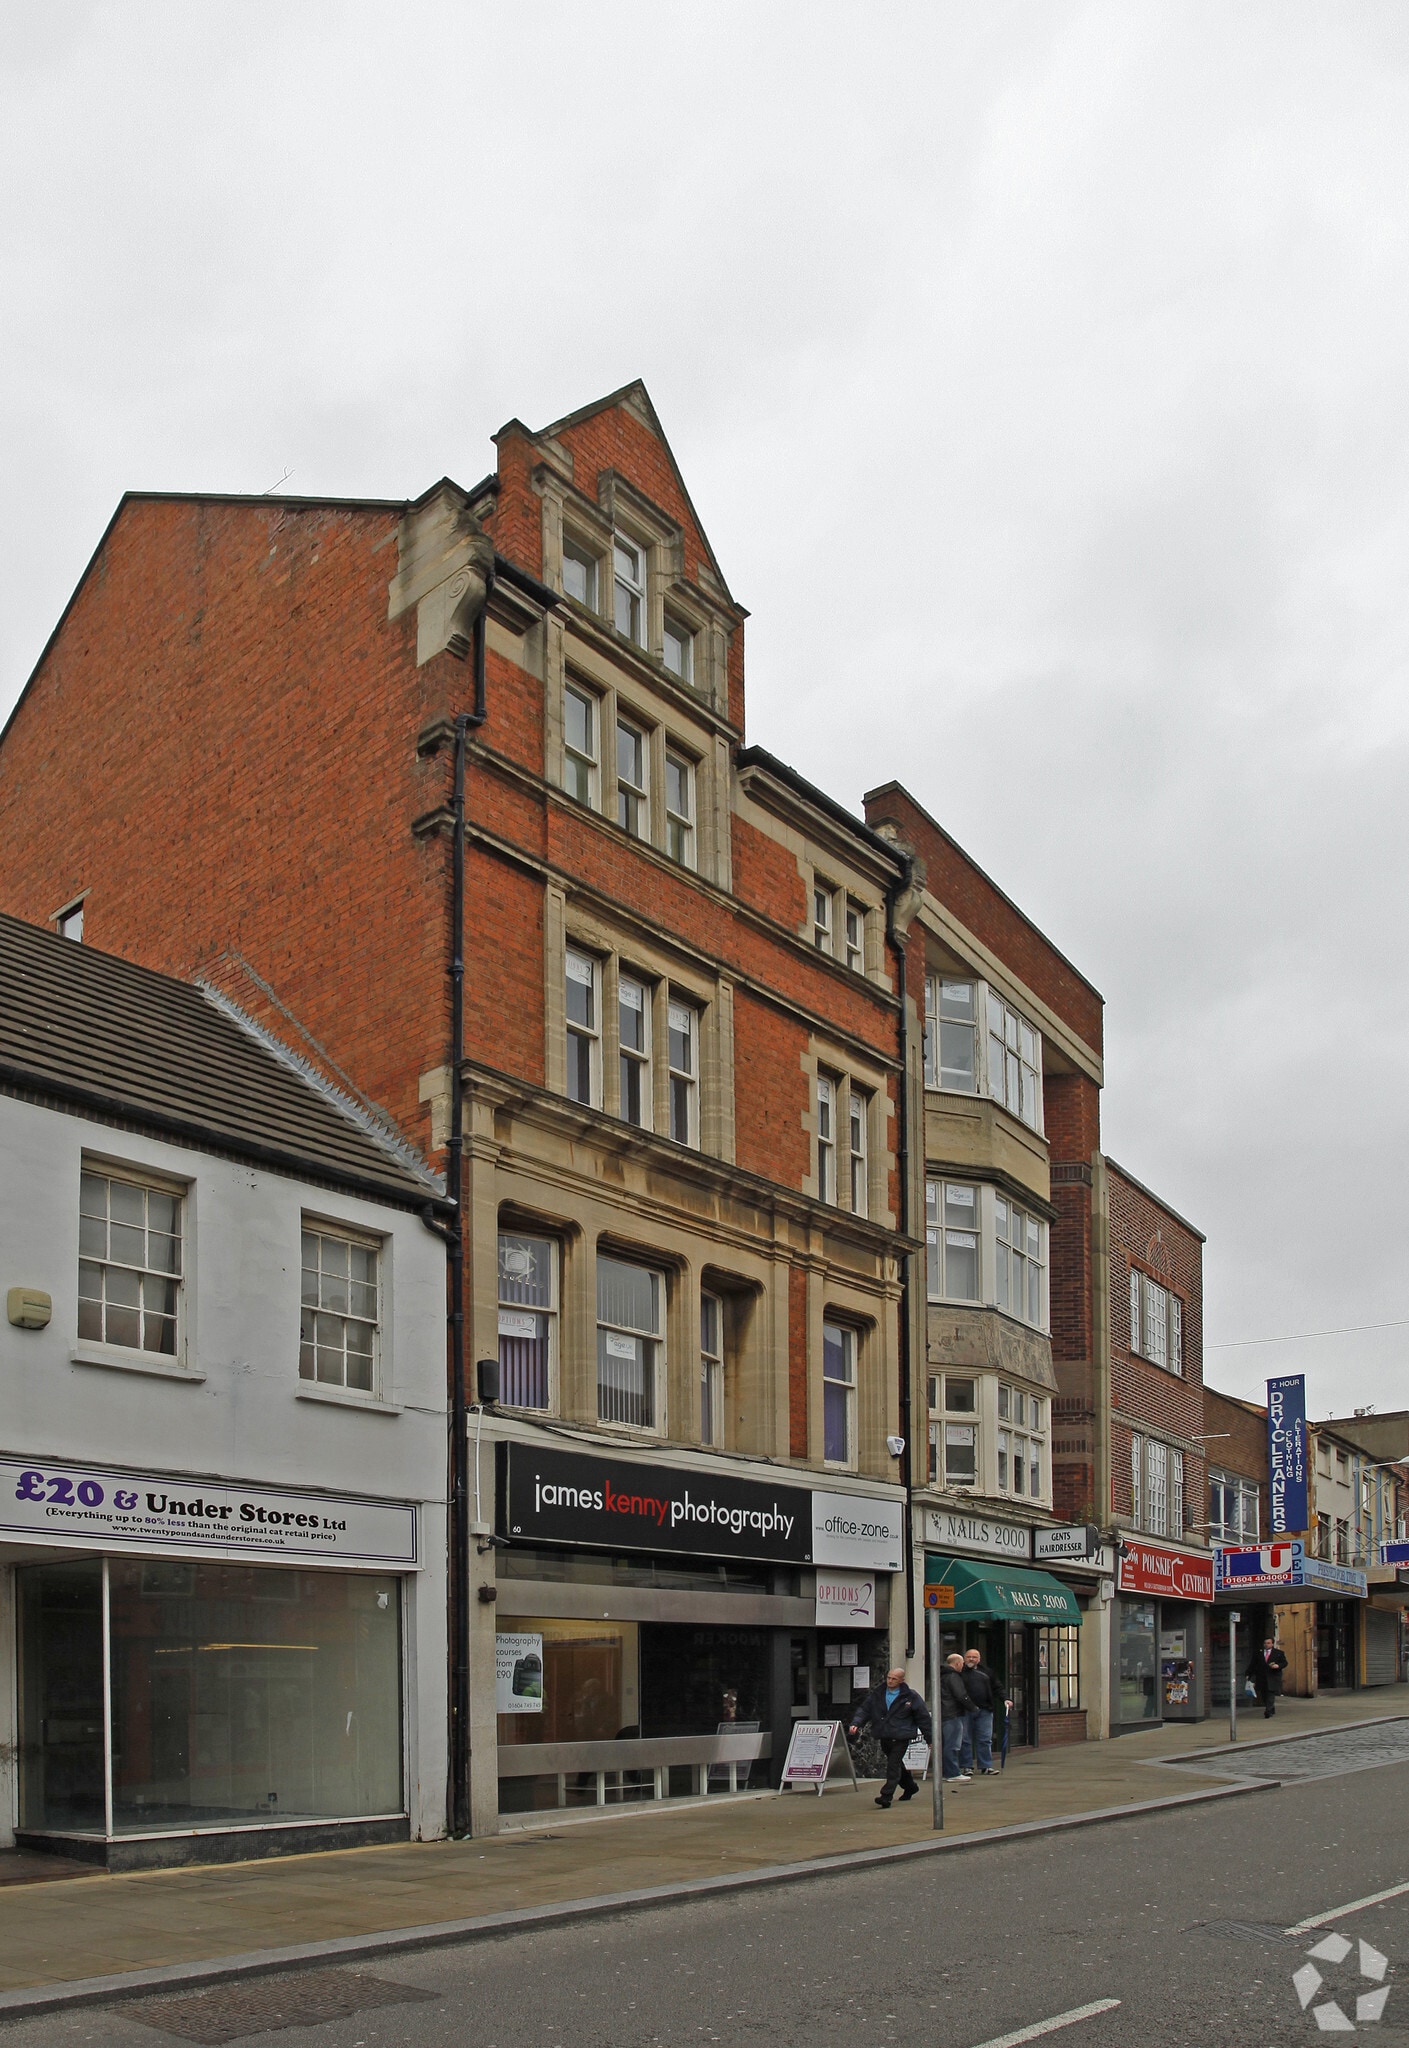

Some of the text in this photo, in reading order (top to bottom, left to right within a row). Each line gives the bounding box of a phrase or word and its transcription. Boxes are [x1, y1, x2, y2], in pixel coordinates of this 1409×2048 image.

[1279, 1379, 1300, 1388] HOUR
[1285, 1430, 1294, 1478] CLOTHING
[1294, 1417, 1303, 1483] ALTERATIONS
[1270, 1391, 1287, 1533] DRYCLEANERS
[15, 1471, 347, 1531] £20 & Under Stores Ltd
[535, 1474, 795, 1540] james kenny photography
[46, 1507, 336, 1541] (Everything up to 80% less than the original cat retail price)
[112, 1524, 285, 1545] www.twentypoundsandunderstores.co.uk
[512, 1525, 522, 1534] 60
[947, 1516, 1026, 1549] NAILS 2000
[1051, 1531, 1071, 1541] GENTS
[1039, 1543, 1082, 1553] HAIRDRESSER
[1142, 1552, 1172, 1577] POLSKIE
[1181, 1572, 1211, 1595] CENTRUM
[1226, 1573, 1289, 1584] 01604 404060
[819, 1582, 873, 1616] OPTIONS 2
[1011, 1591, 1068, 1610] NAILS 2000
[496, 1635, 540, 1647] Photography
[496, 1658, 513, 1667] from
